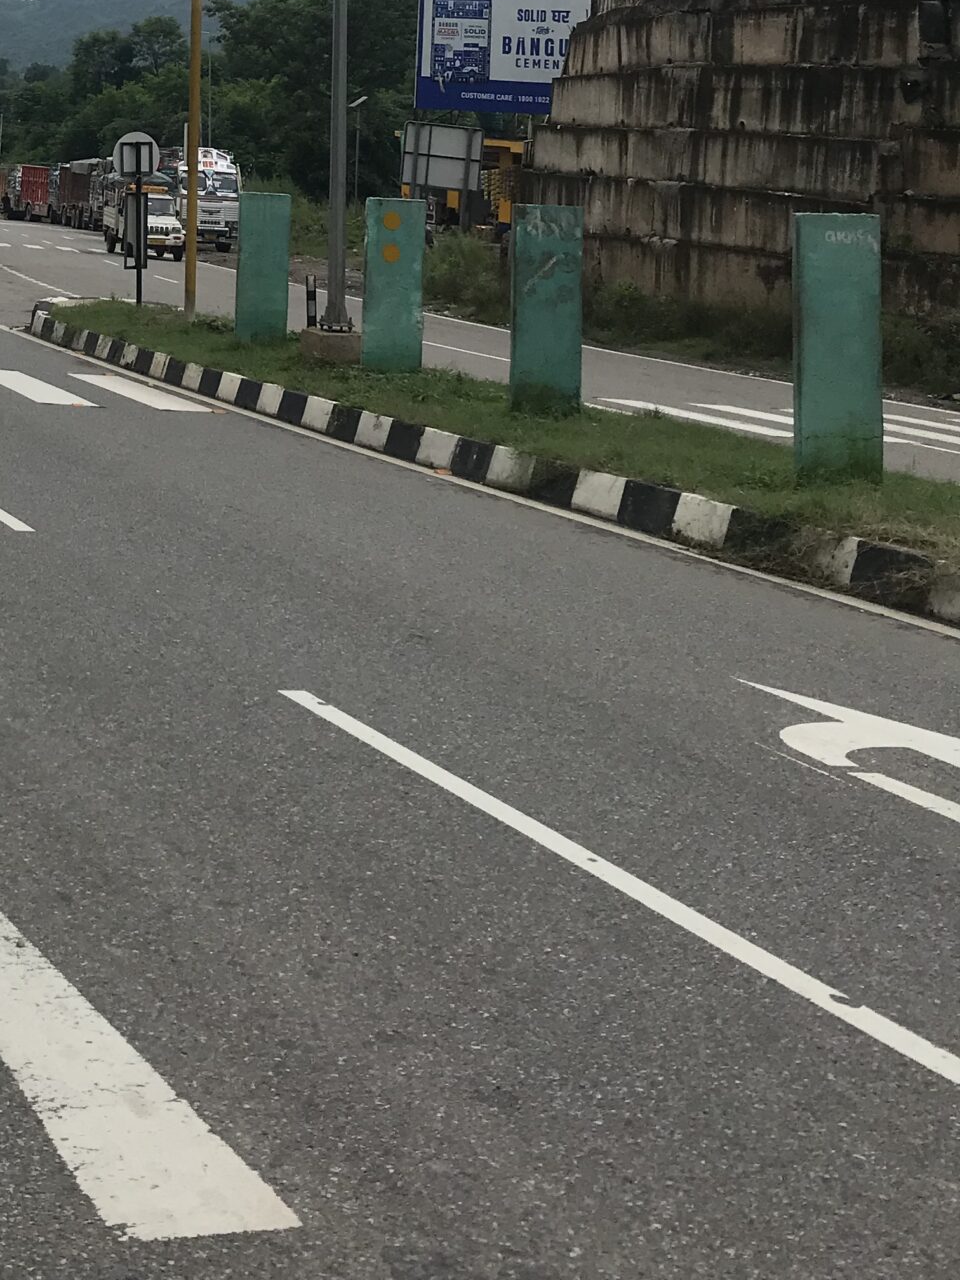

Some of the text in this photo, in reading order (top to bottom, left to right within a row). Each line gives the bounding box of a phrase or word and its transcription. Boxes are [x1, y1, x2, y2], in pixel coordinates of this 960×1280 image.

[517, 8, 571, 23] SOLID घर
[502, 35, 570, 58] BANGU
[515, 57, 564, 70] CEMEN
[460, 91, 495, 101] CUSTOMER
[495, 93, 513, 102] CARE
